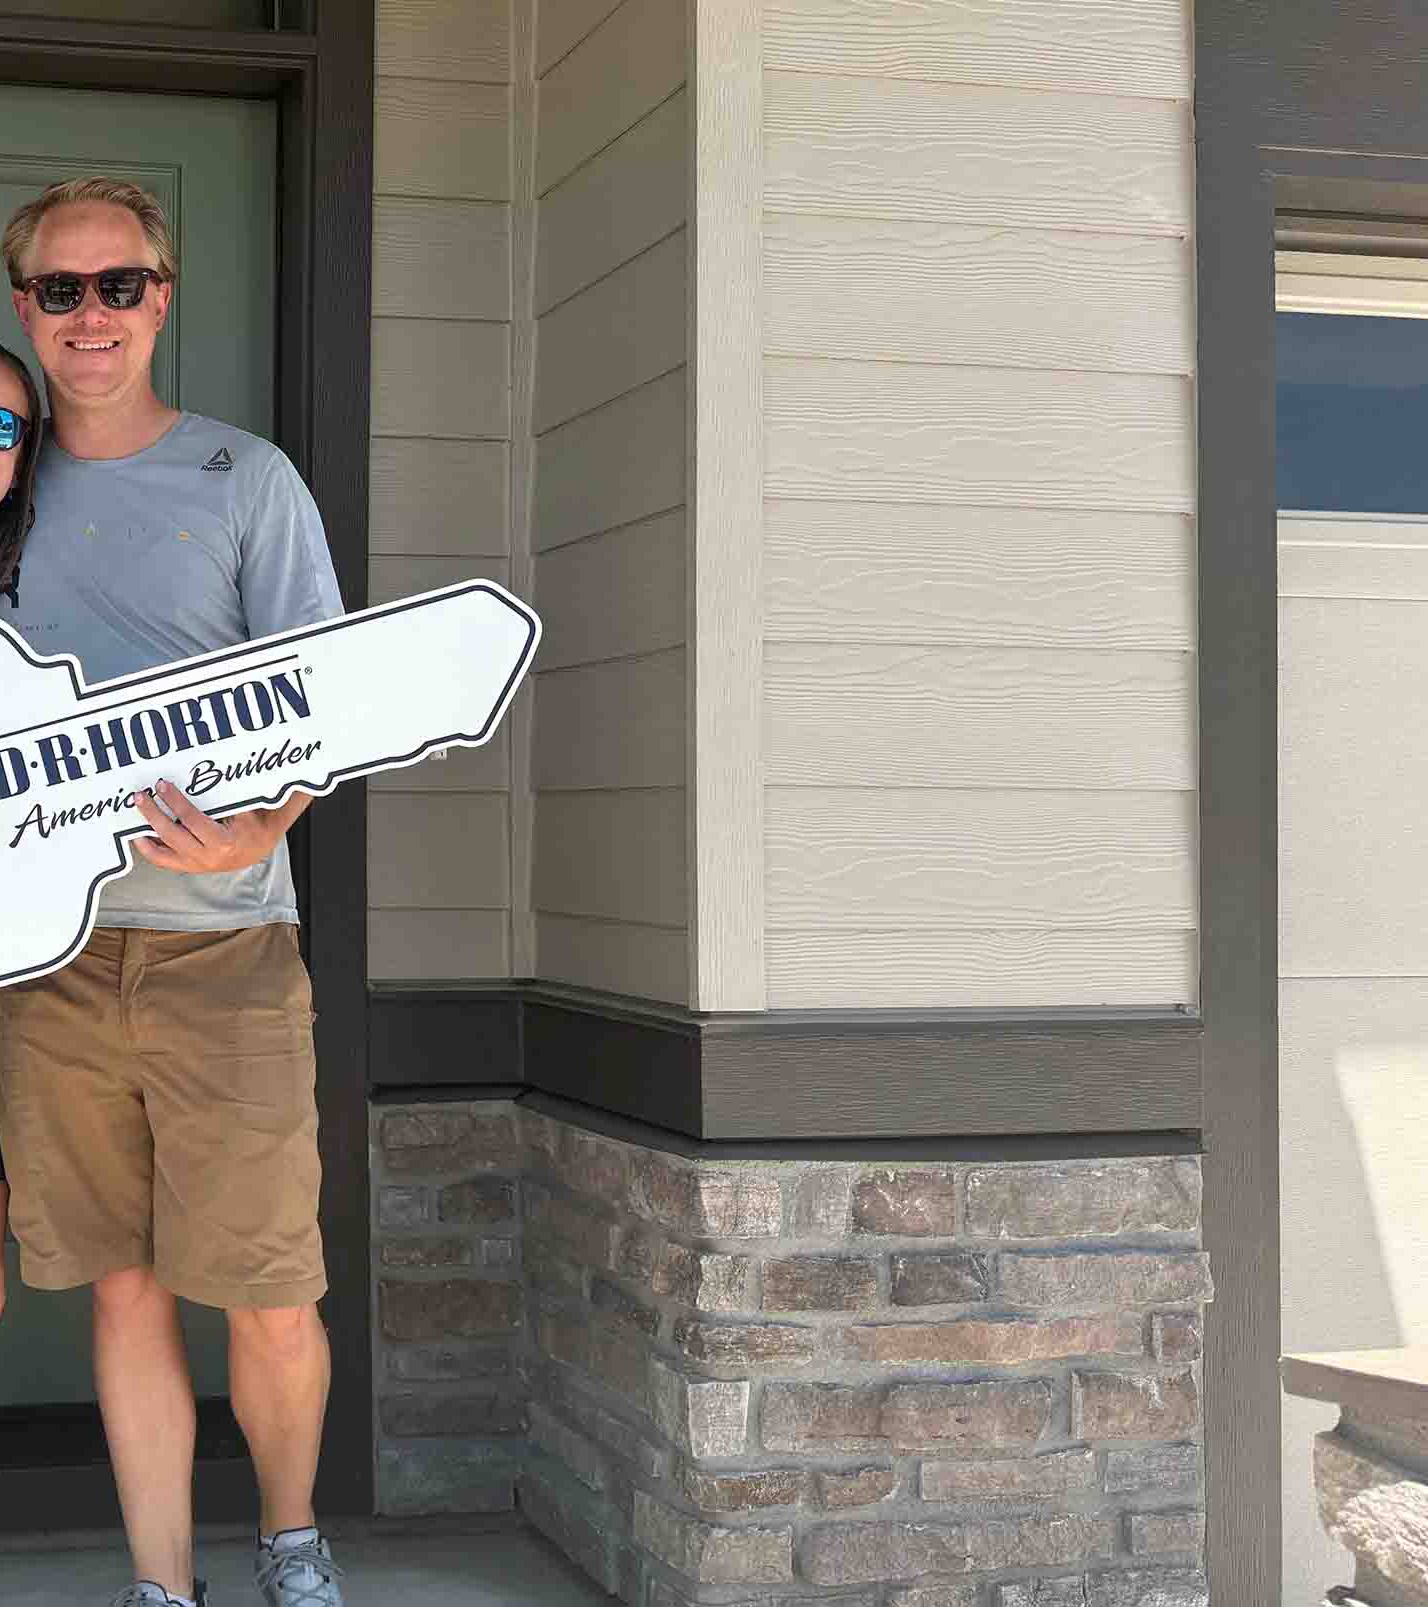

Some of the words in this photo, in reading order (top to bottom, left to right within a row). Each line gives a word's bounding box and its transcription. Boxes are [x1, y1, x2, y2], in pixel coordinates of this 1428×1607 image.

[200, 464, 234, 472] Reebok
[9, 778, 164, 848] Americ
[185, 738, 322, 797] Builder
